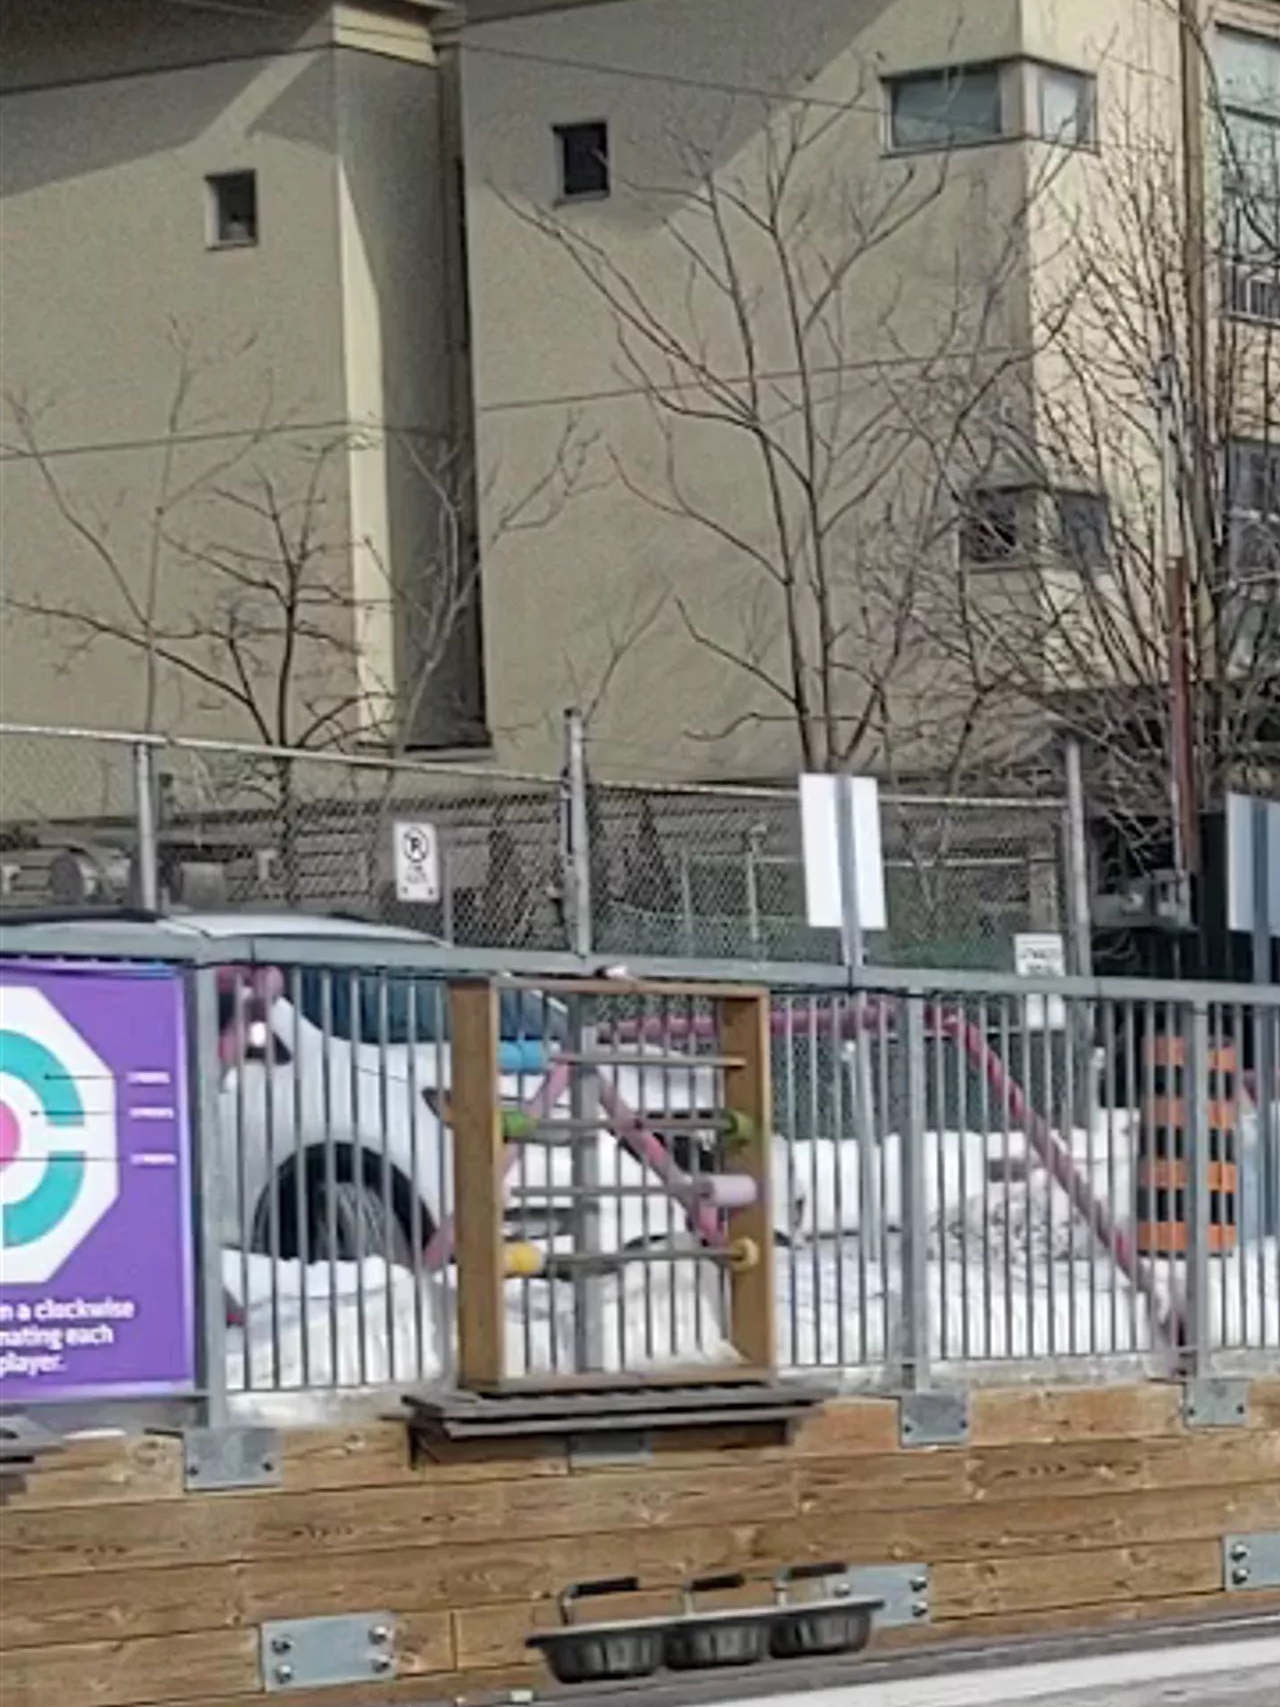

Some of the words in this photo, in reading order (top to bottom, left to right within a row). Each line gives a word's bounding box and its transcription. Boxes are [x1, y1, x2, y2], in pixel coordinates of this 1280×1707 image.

[16, 1303, 31, 1321] a
[34, 1297, 135, 1320] clockwise
[65, 1324, 114, 1346] each
